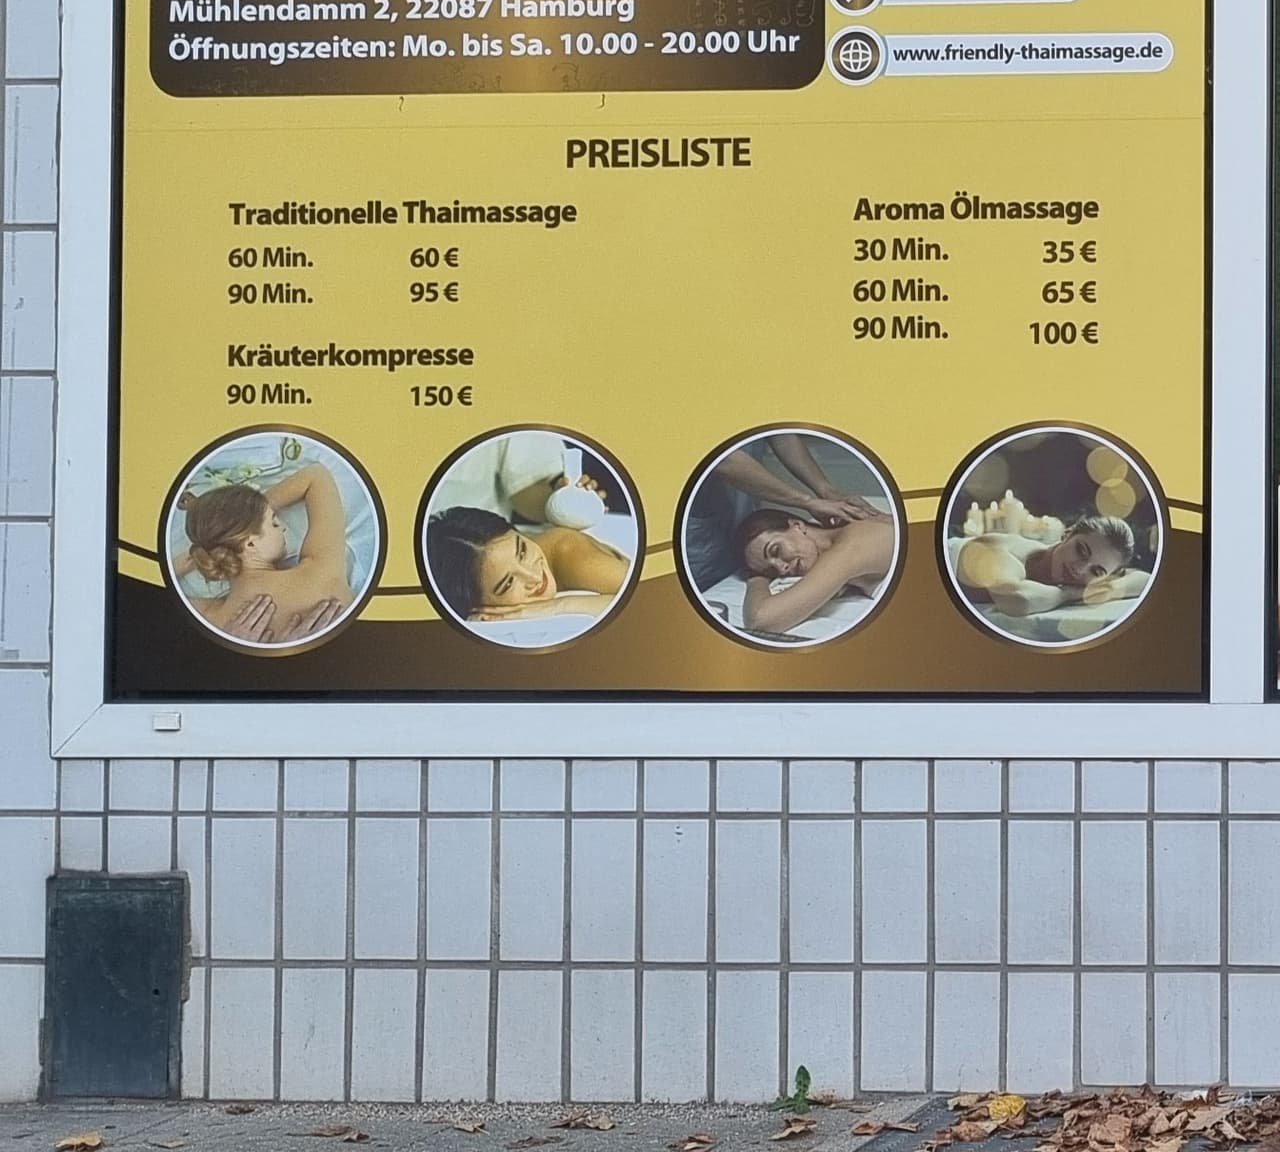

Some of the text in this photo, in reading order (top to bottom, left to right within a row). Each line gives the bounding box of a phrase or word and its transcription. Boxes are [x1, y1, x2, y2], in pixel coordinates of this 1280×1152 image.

[169, 34, 395, 65] Öffnungszeiten:
[403, 35, 455, 56] Mo.
[463, 34, 502, 56] bis
[511, 34, 551, 55] Sa.
[561, 33, 637, 54] 10.00
[661, 32, 739, 53] 20.00
[748, 29, 800, 52] Uhr
[893, 42, 1162, 64] www.friendly-thaimassage.de
[567, 138, 751, 168] PREISLISTE
[229, 200, 576, 228] Traditionelle Thaimassage
[854, 191, 1099, 224] Aroma Ölmassage
[229, 247, 313, 267] 60 Min.
[411, 248, 459, 268] 60 €
[854, 237, 948, 261] 30 Min.
[1043, 241, 1096, 263] 35 €
[228, 283, 312, 304] 90 Min.
[410, 282, 459, 302] 95 €
[854, 278, 948, 301] 60 Min.
[1043, 281, 1096, 304] 65 €
[853, 316, 948, 339] 90 Min.
[1030, 322, 1099, 345] 100 €
[229, 343, 473, 372] Kräuterkompresse
[227, 383, 311, 404] 90 Min.
[411, 386, 473, 406] 150 €
